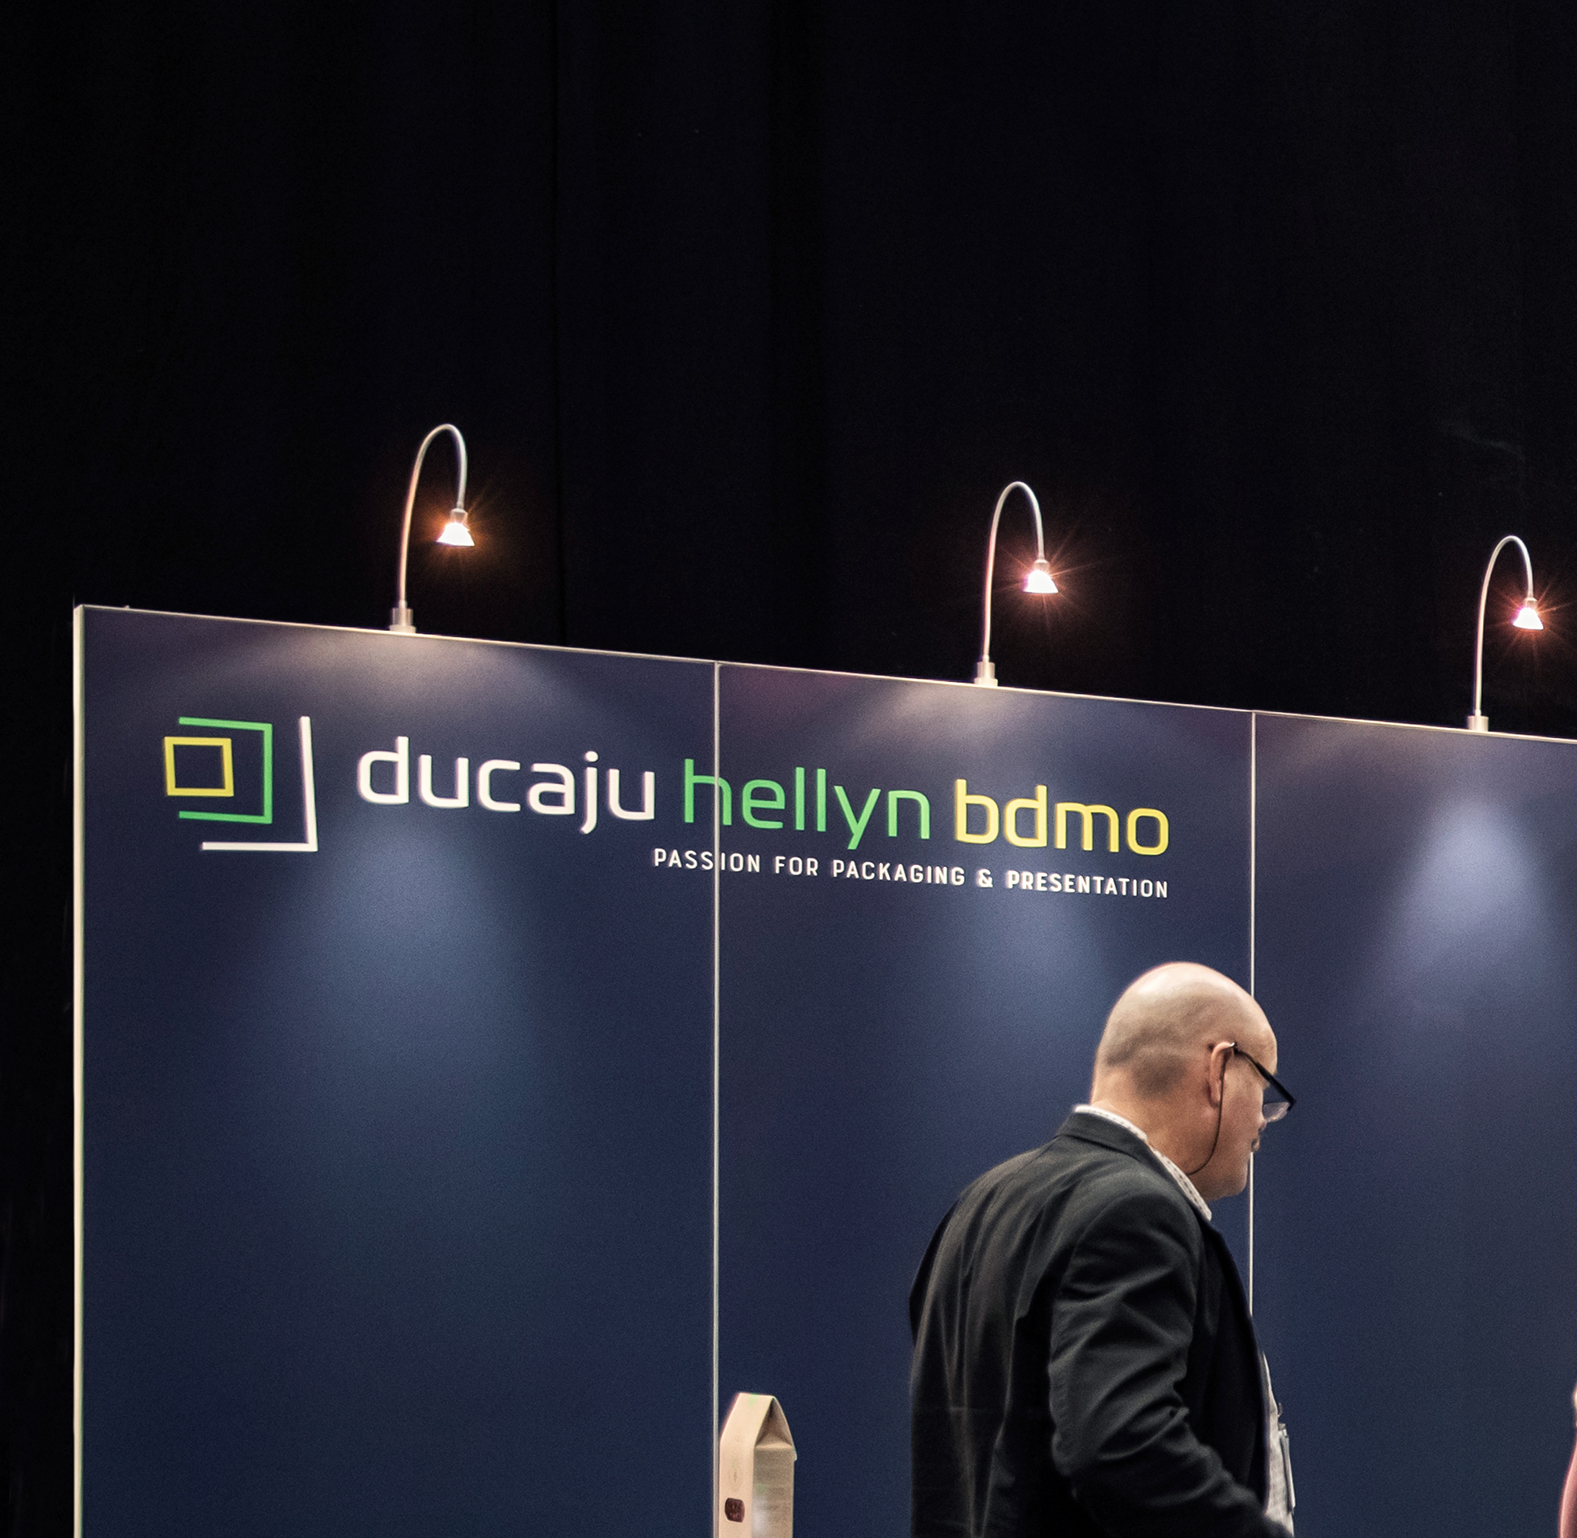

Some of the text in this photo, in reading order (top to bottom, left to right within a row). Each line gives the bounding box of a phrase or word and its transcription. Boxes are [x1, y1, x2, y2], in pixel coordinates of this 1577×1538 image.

[357, 736, 1170, 856] ducaju hellyn bdmo
[654, 848, 1169, 898] PASSION FOR PACKAGING & PRESENTATION
